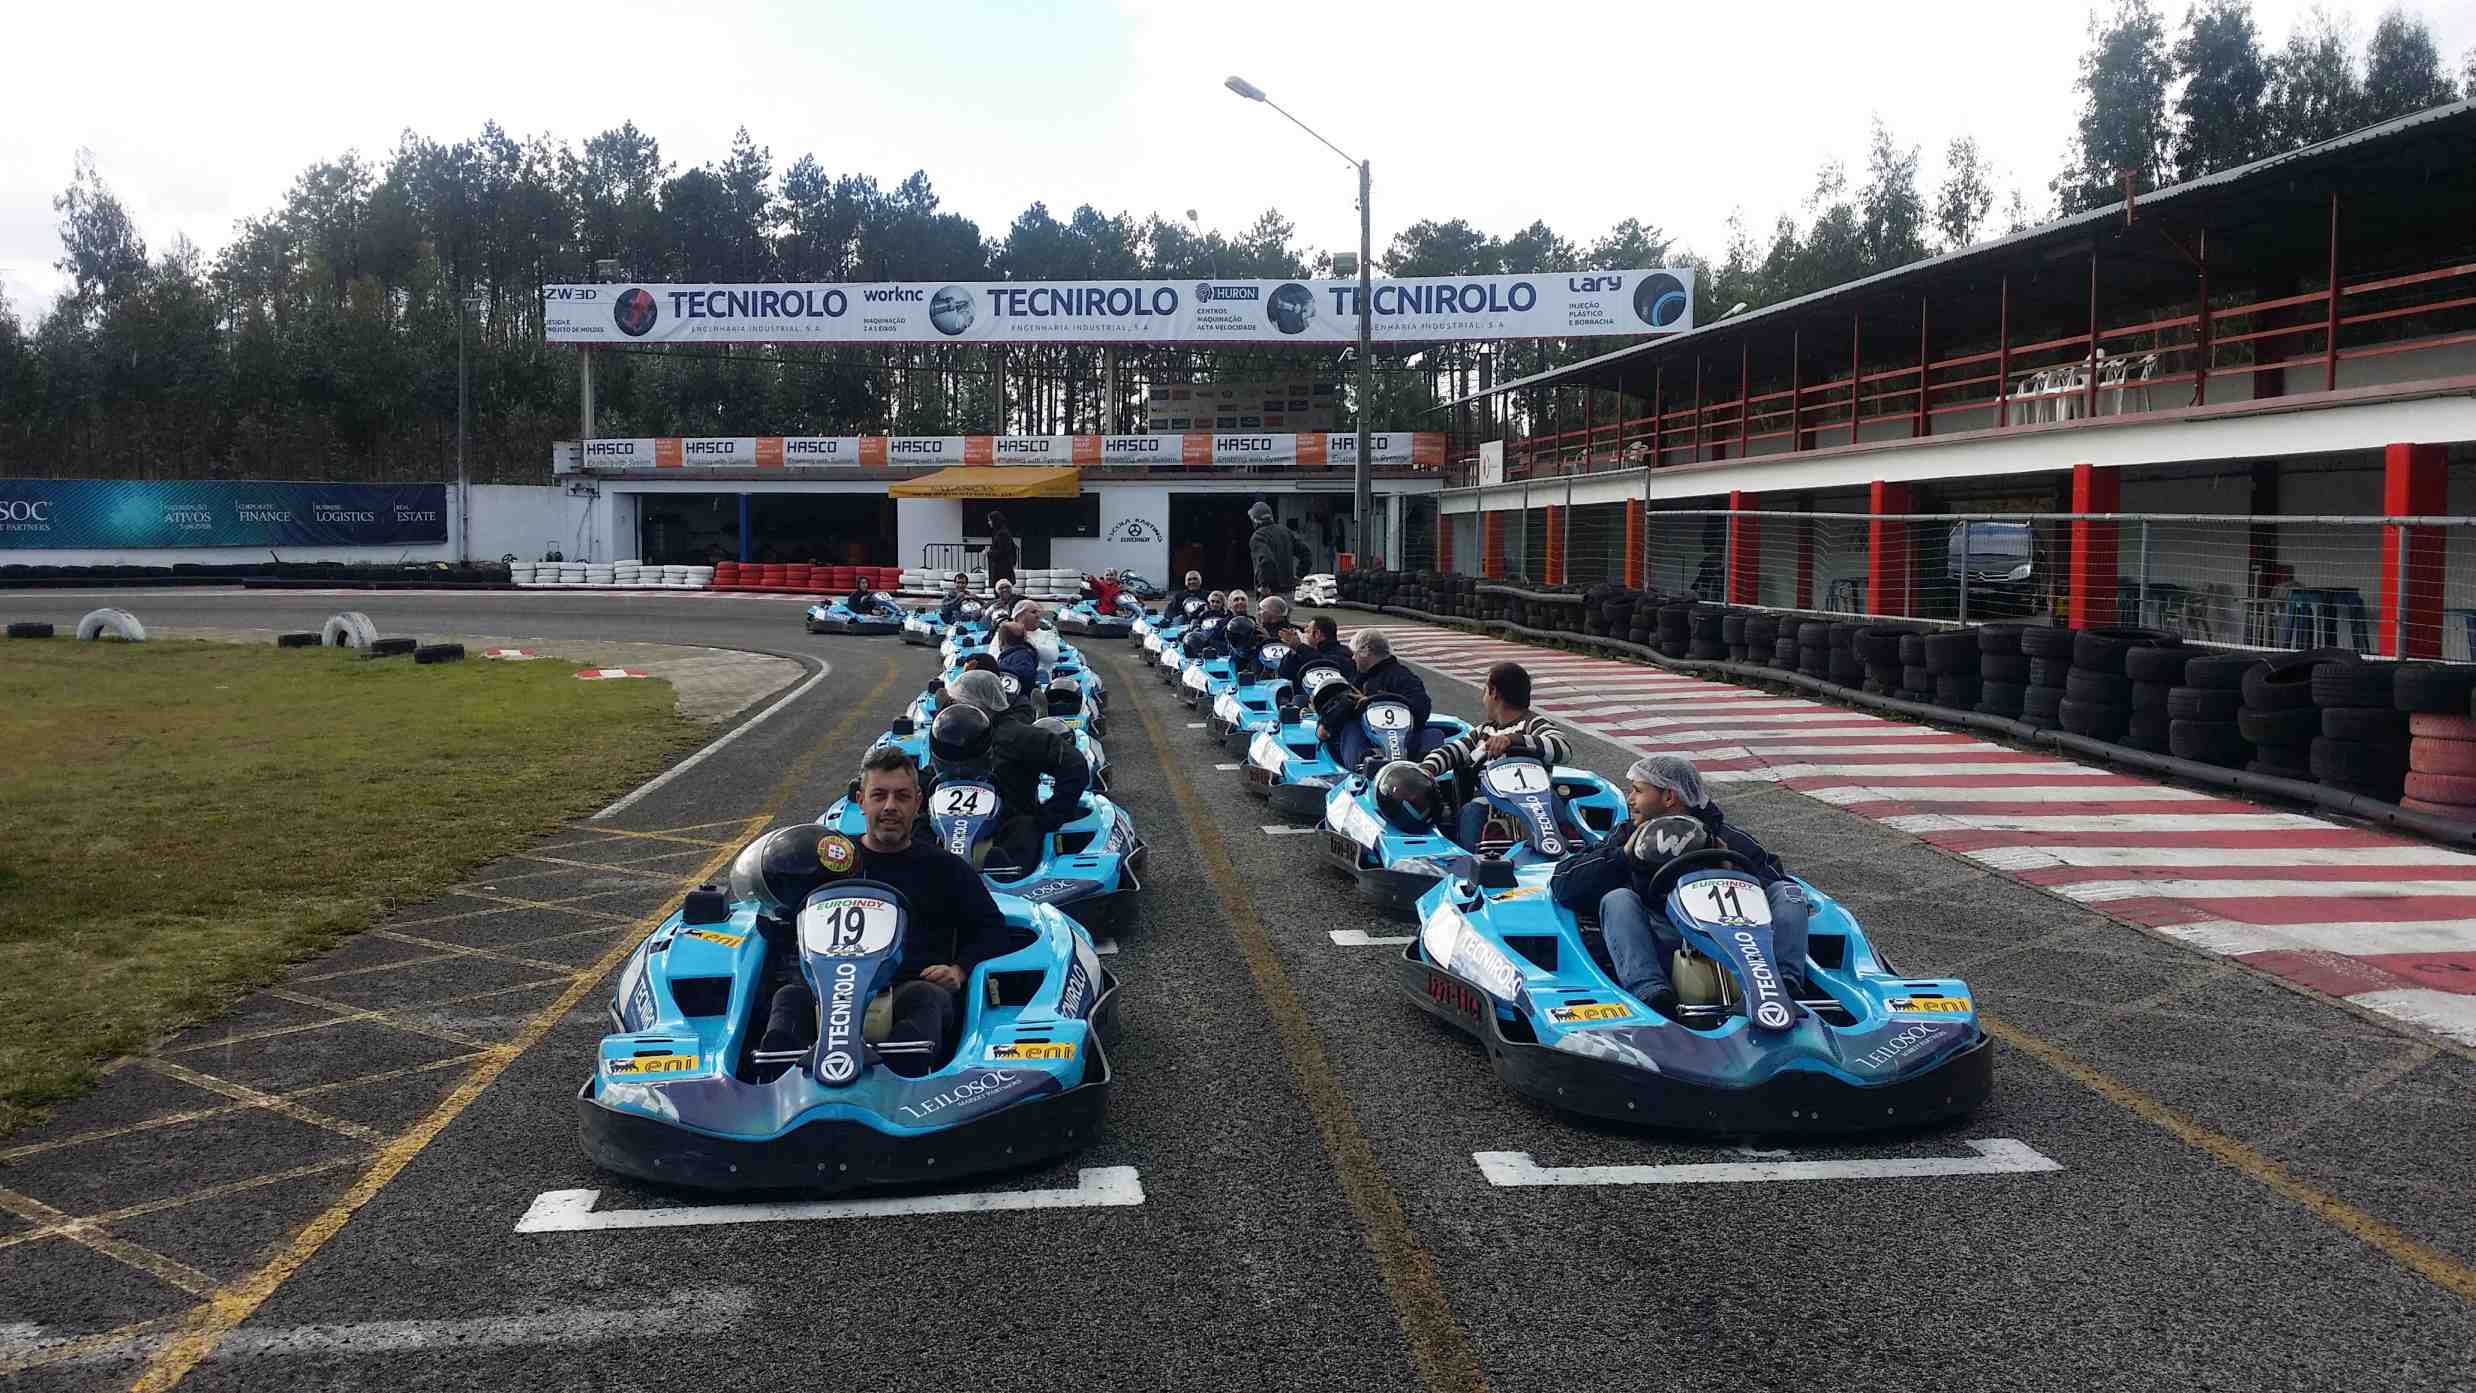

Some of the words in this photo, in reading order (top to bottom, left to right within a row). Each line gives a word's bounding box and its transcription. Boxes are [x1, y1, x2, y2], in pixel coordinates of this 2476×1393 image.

[863, 286, 924, 302] worknc
[1216, 286, 1257, 299] HURON
[667, 289, 848, 319] TECNIROLO
[986, 286, 1179, 318] TECNIROLO
[1010, 323, 1069, 332] ENGENHARIA
[586, 442, 634, 455] HASCO
[685, 440, 735, 454] HASCO
[787, 440, 838, 453] HASCO
[891, 440, 943, 453] HASCO
[996, 439, 1050, 453] HASCO
[1105, 439, 1159, 452] HASCO
[1217, 437, 1272, 451] HASCO
[1330, 436, 1388, 451] HAO
[165, 511, 212, 522] ATIVOS
[239, 511, 291, 522] FINANCE
[316, 511, 375, 522] LOGISTICS
[397, 511, 436, 521] ESTATE
[1384, 709, 1395, 725] 9
[1513, 767, 1528, 789] 1
[946, 789, 978, 812] 24
[950, 819, 969, 855] ECNIROLO
[1691, 880, 1753, 890] EUROINDY
[816, 896, 885, 912] EUROINDY
[1707, 885, 1744, 918] 11
[826, 906, 866, 946] 19
[1461, 934, 1524, 1001] TECNIROLO
[1735, 931, 1780, 1001] TECNIROLO
[828, 962, 857, 1051] TECNIROLO
[1583, 1002, 1628, 1019] eni
[1923, 1000, 1969, 1012] eni
[1024, 1043, 1074, 1060] eni
[1855, 1020, 1940, 1069] LEILOSOC
[644, 1055, 693, 1073] eni
[899, 1068, 1017, 1119] LEILOSOC
